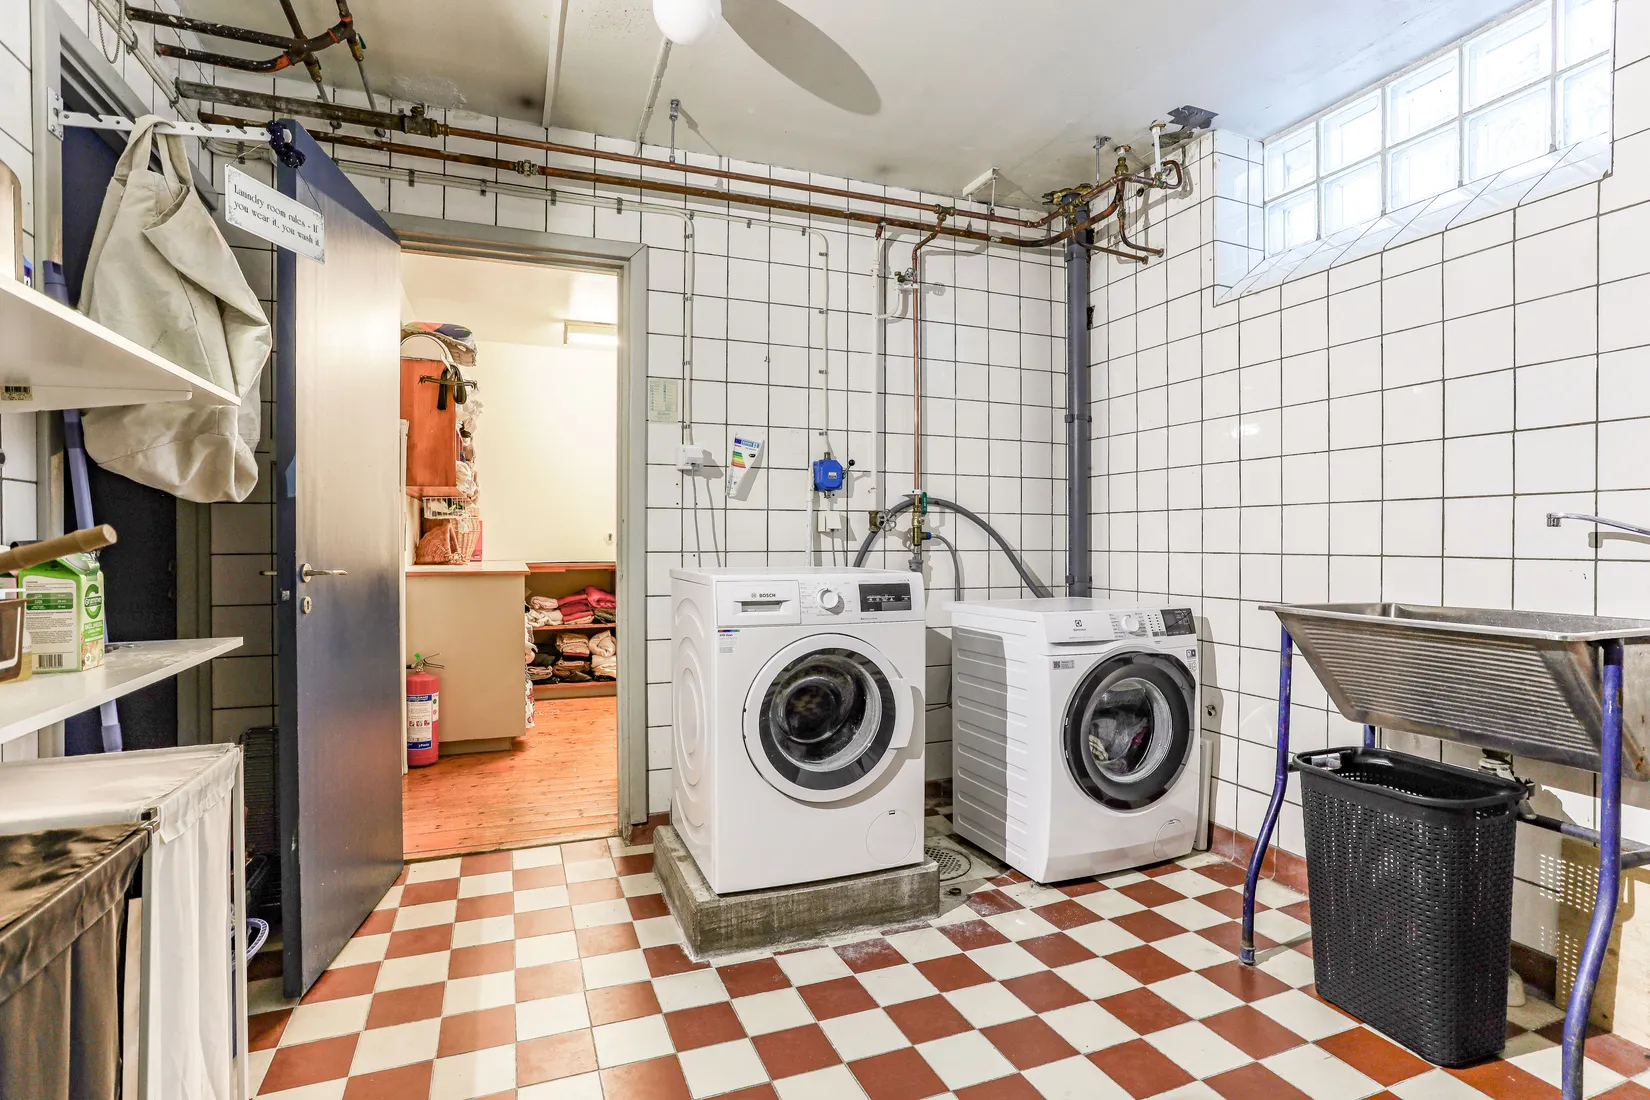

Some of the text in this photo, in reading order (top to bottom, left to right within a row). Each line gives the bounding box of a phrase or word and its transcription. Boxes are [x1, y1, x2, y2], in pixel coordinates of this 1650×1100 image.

[233, 201, 249, 213] you
[251, 210, 270, 223] wear
[281, 223, 295, 235] you
[297, 230, 313, 243] wash
[234, 184, 264, 208] Laundry
[266, 203, 286, 218] room
[289, 214, 306, 227] rules
[313, 224, 319, 233] If
